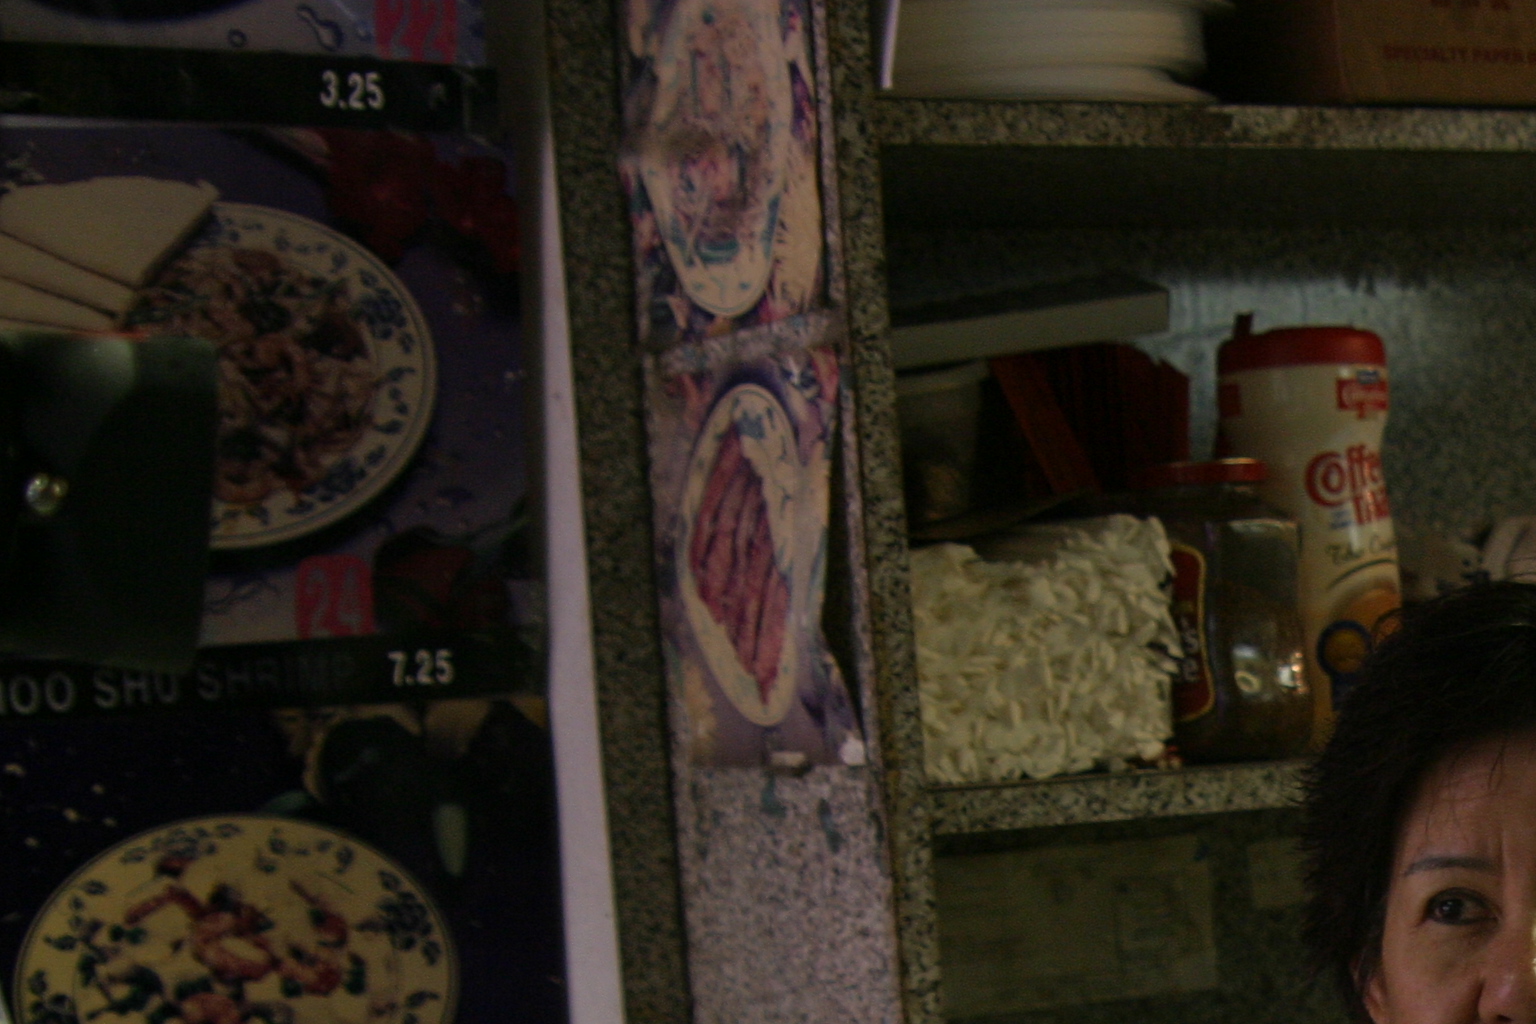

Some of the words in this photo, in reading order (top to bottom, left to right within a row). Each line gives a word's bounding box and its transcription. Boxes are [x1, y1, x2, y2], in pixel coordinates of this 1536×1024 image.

[319, 68, 386, 111] 3.25
[0, 674, 76, 716] OO
[197, 651, 355, 701] SHRIMP
[387, 648, 456, 686] 7.25
